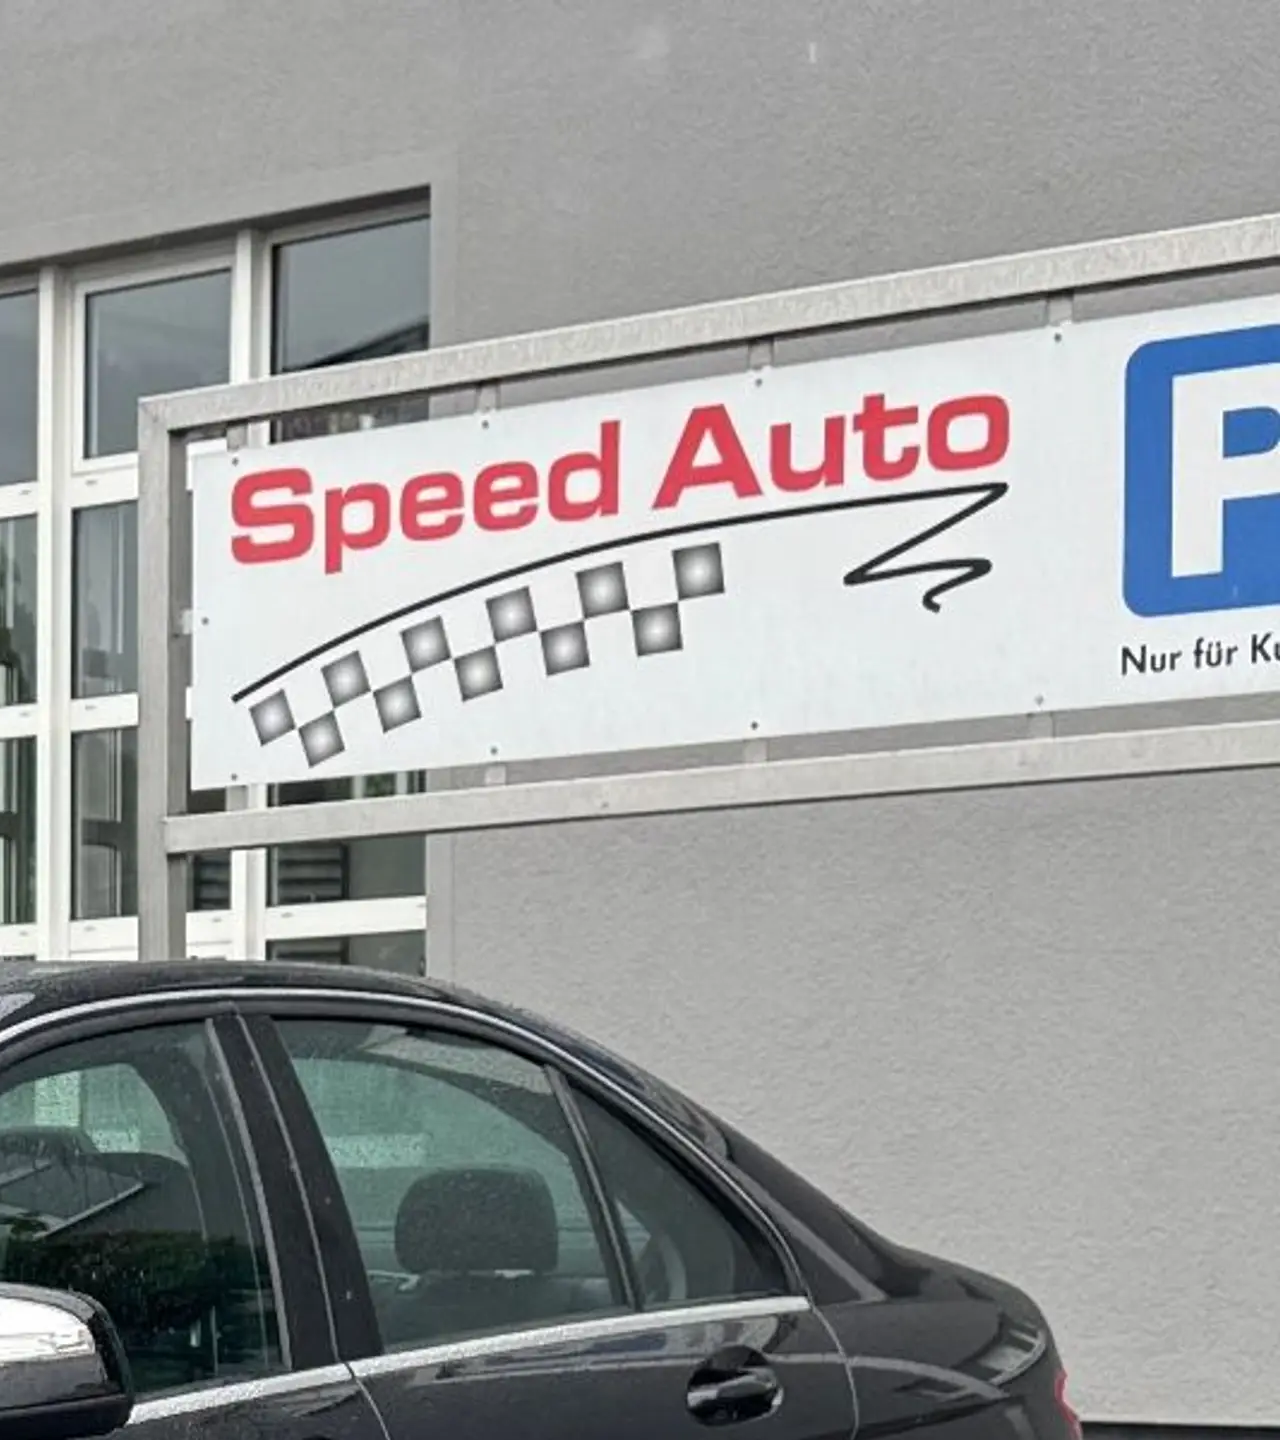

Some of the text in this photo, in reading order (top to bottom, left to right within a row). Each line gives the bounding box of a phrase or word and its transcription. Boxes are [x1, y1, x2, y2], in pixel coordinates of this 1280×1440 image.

[231, 394, 1008, 574] Speed Auto
[1121, 645, 1182, 675] Nur
[1194, 637, 1238, 669] für
